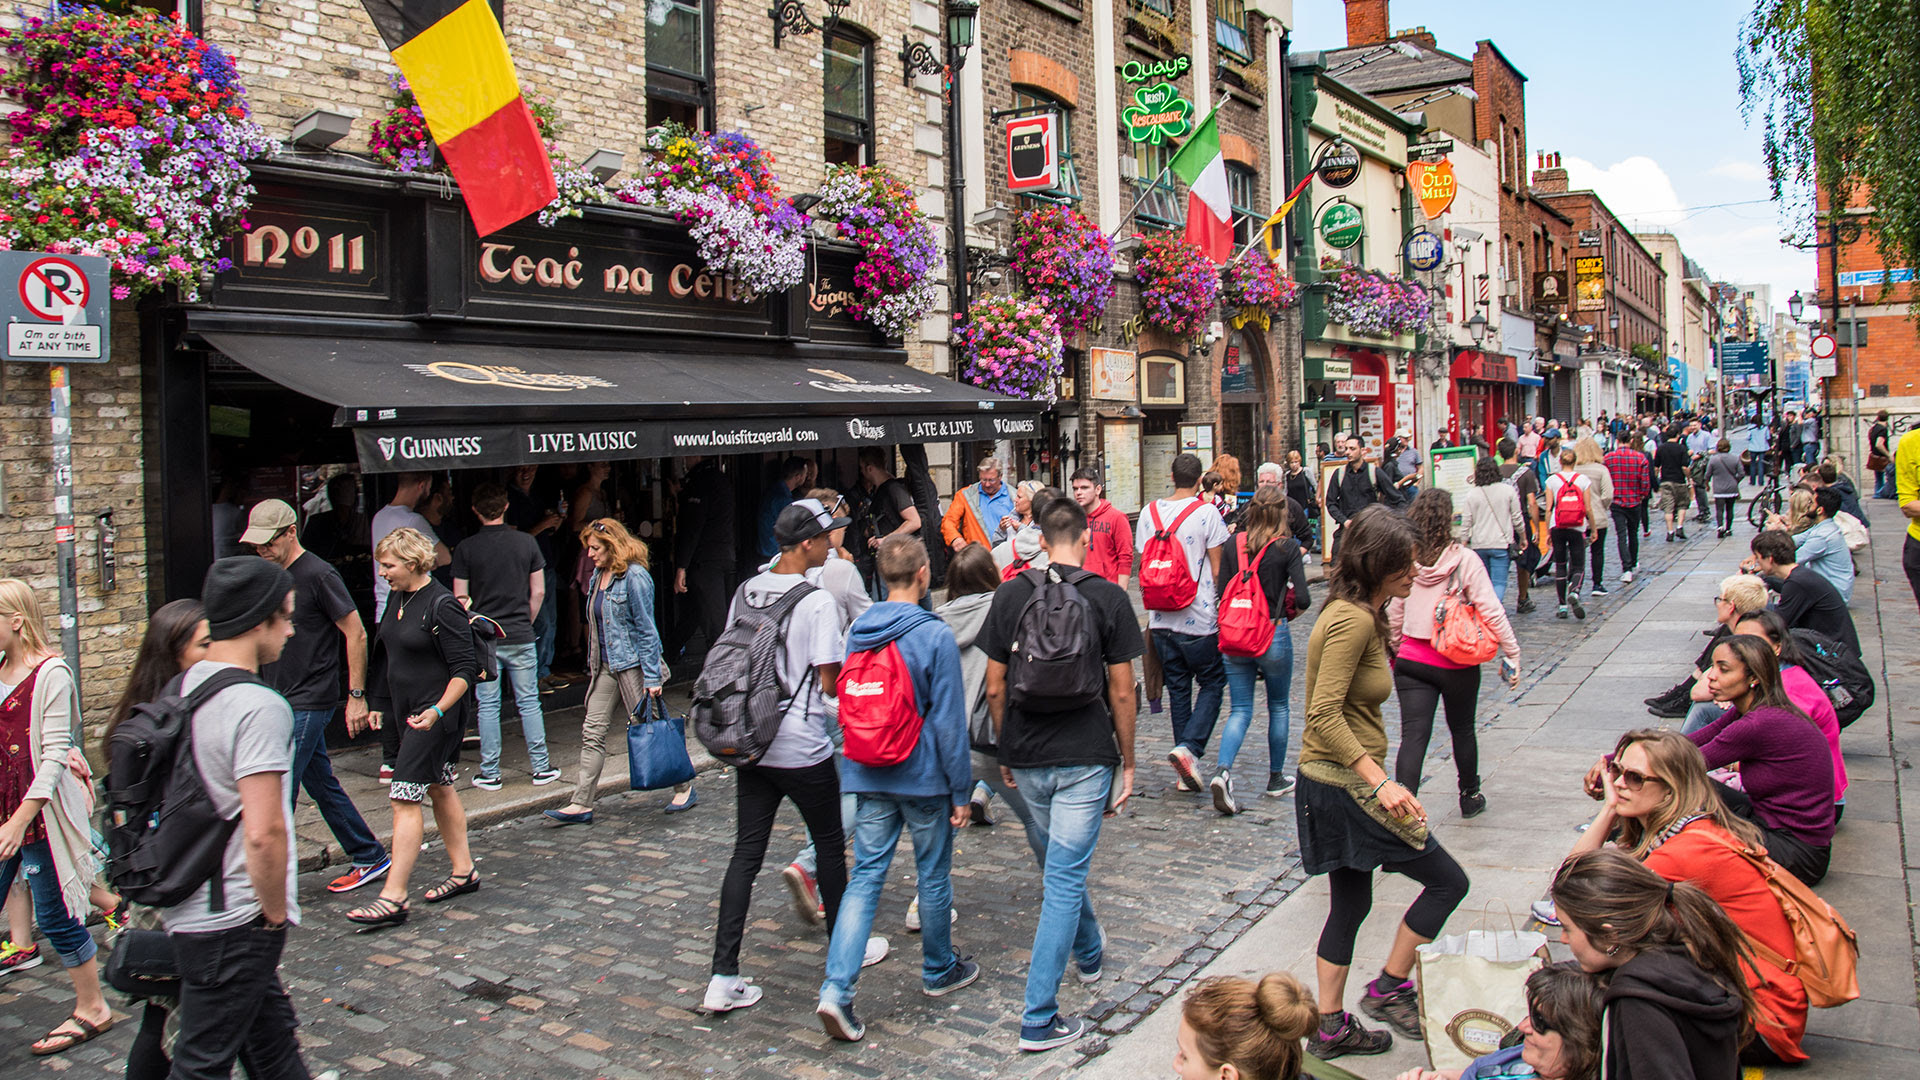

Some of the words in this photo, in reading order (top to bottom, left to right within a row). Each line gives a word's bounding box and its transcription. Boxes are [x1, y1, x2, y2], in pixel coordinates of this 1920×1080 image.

[1121, 56, 1190, 82] Quays
[1320, 156, 1357, 168] UINNESS
[1421, 172, 1453, 188] OLD
[1422, 188, 1454, 200] MILL
[1576, 257, 1604, 268] RORY'S
[604, 264, 654, 297] na
[19, 341, 33, 350] AT
[37, 342, 61, 351] ANY
[66, 342, 92, 352] TIME
[673, 427, 819, 447] www.louisfitzgeraldcom
[908, 422, 938, 438] LATE
[939, 421, 949, 436] &
[949, 420, 975, 436] LIVE
[400, 436, 482, 459] GUINNESS
[528, 433, 576, 453] LIVE
[577, 430, 638, 451] MUSIC
